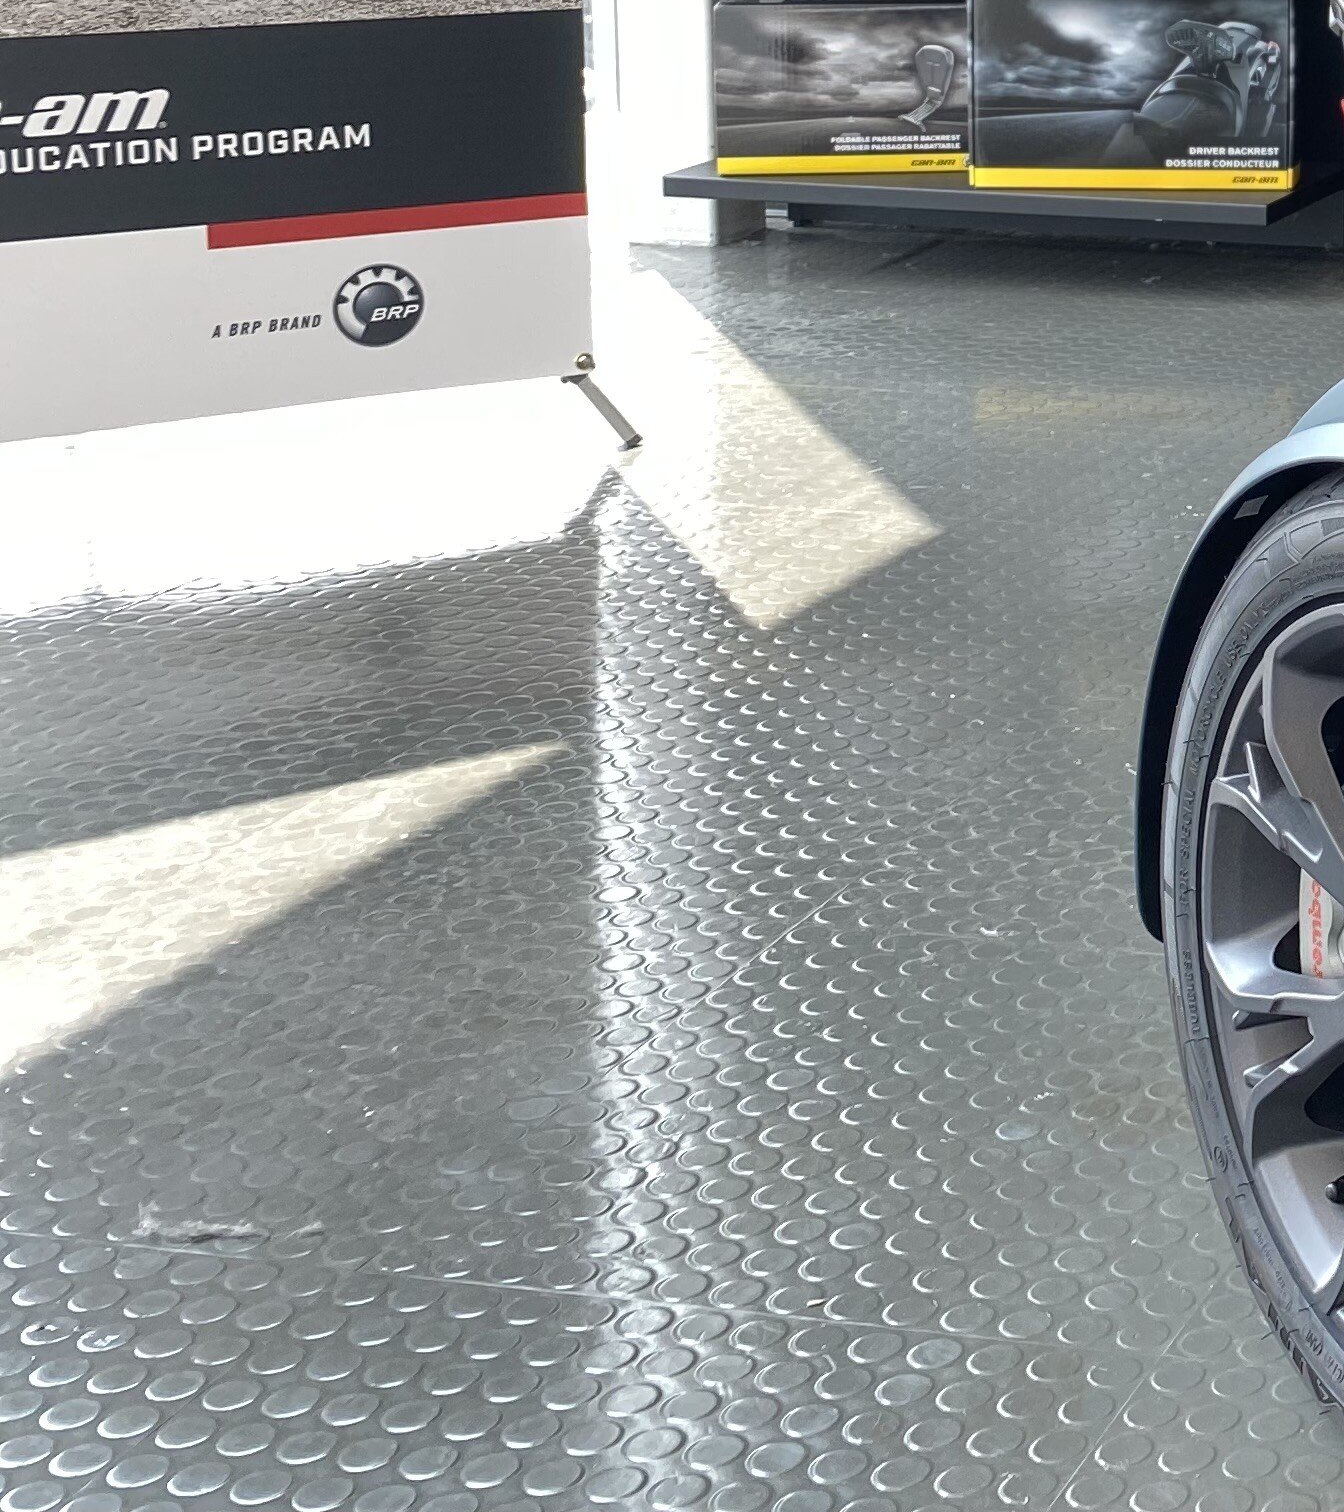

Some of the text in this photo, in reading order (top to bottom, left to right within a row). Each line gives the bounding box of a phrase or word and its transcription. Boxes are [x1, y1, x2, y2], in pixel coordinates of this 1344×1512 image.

[0, 88, 170, 138] -am
[192, 123, 371, 161] PROGRAM
[920, 134, 961, 142] BACKREST
[1188, 147, 1279, 156] DRIVER BACKREST
[911, 159, 956, 167] can-am
[1165, 159, 1279, 168] DOSSIER CONDUCTEUR
[1232, 176, 1279, 184] can-am
[370, 303, 420, 323] BRP
[211, 314, 322, 339] A BRP BRAND
[1308, 879, 1323, 979] rembo
